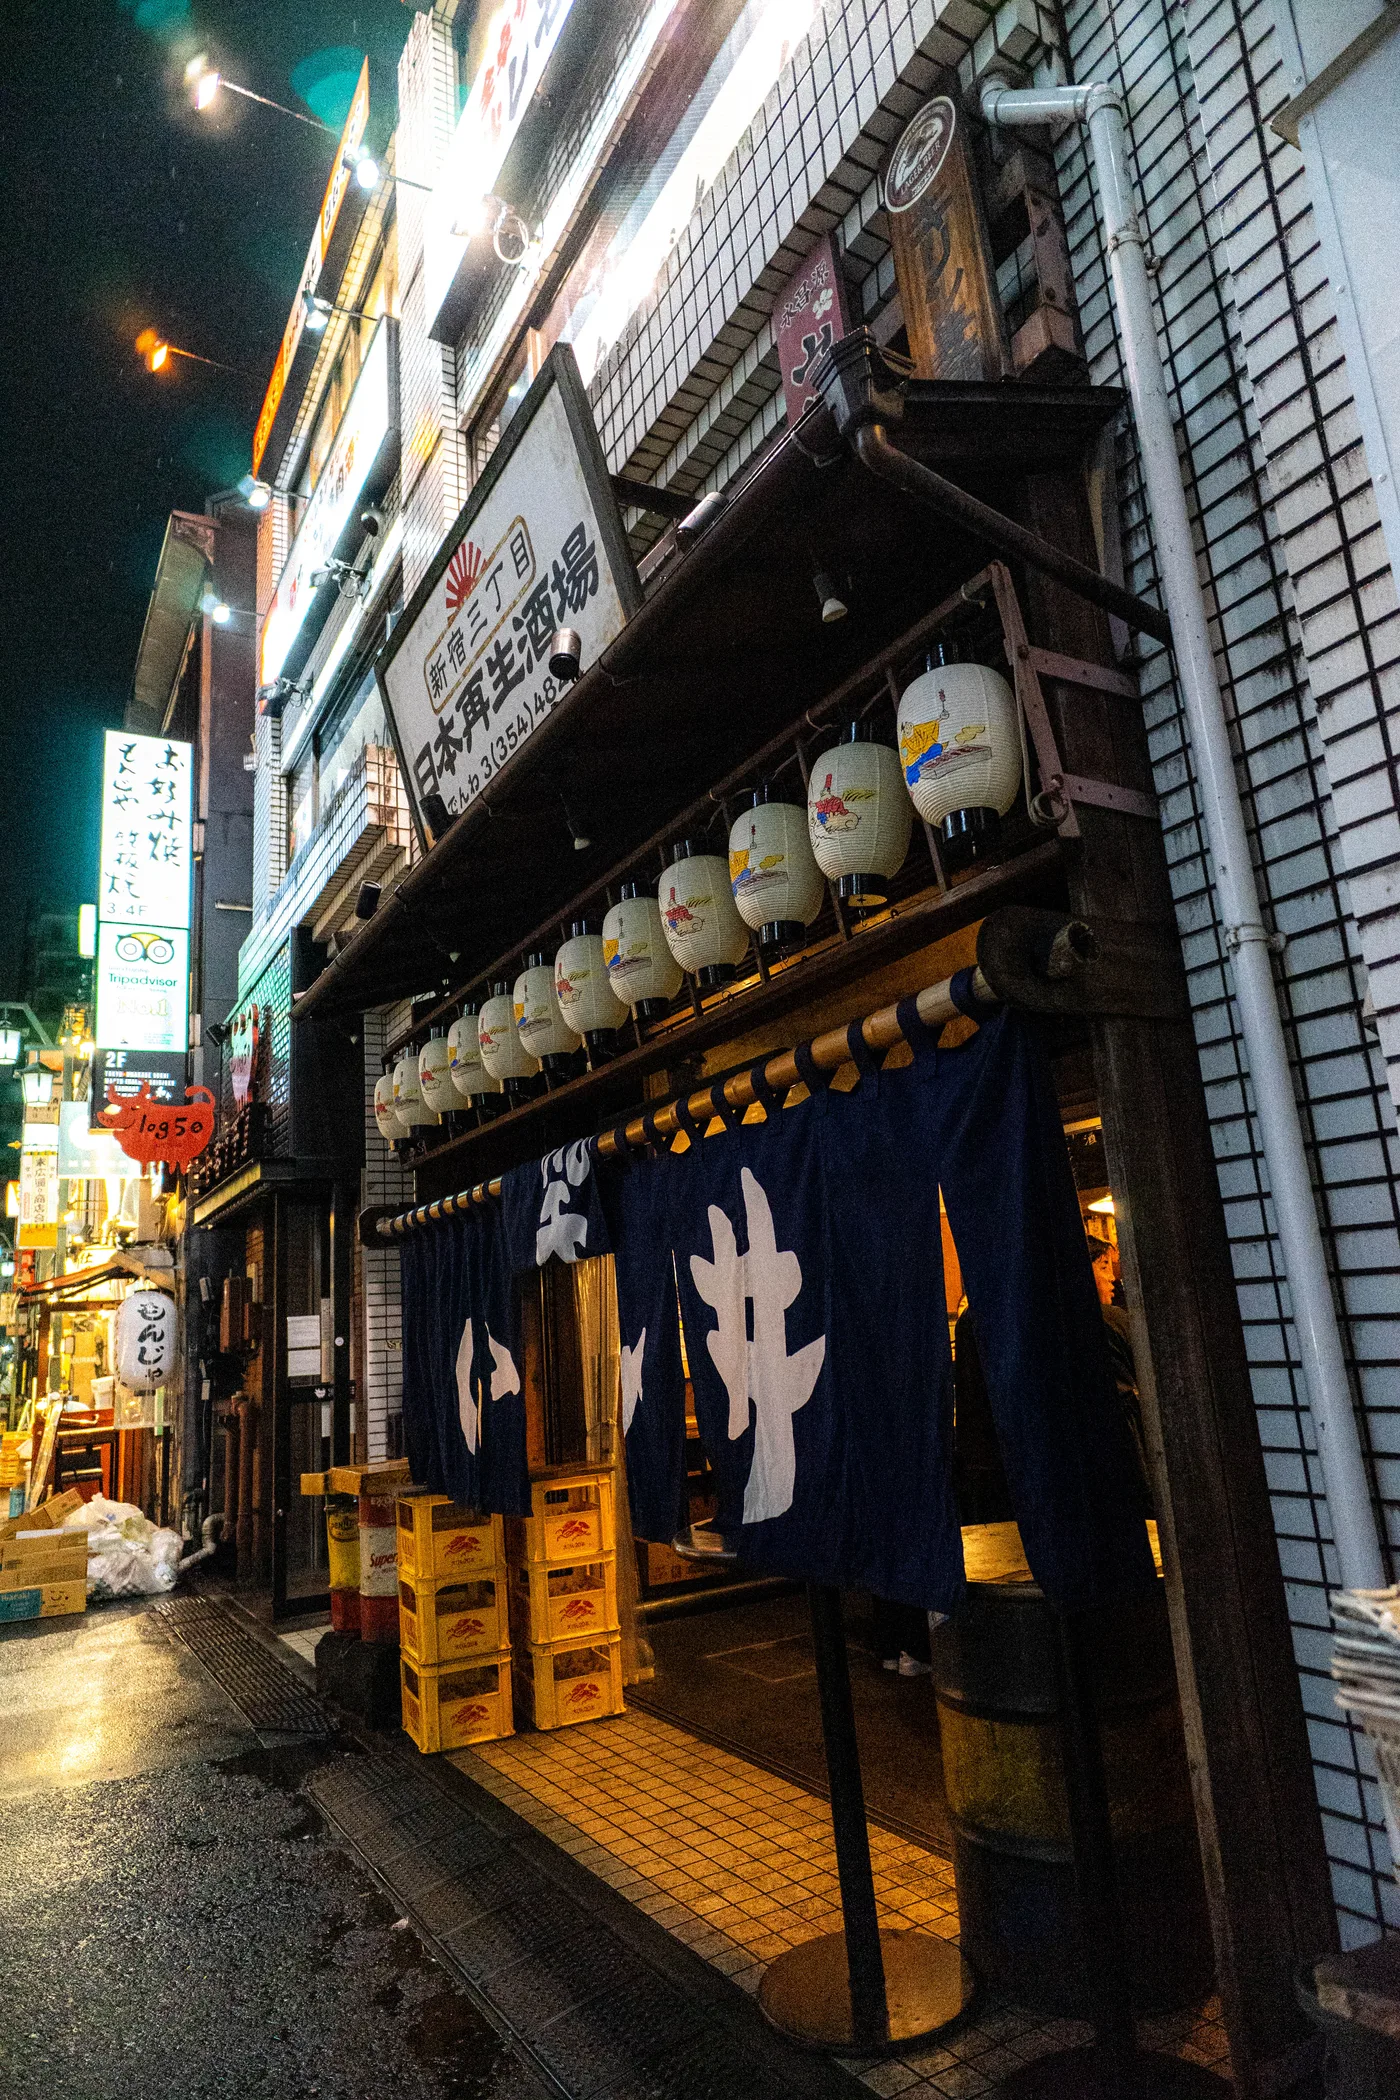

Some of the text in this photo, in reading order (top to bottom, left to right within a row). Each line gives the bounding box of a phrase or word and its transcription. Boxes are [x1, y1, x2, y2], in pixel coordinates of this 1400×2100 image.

[900, 163, 923, 195] LAGER
[922, 140, 941, 166] BEER
[429, 531, 531, 699] 新宿三丁目
[412, 521, 599, 799] 日本再生酒場
[108, 972, 178, 988] Tripadvisor
[105, 1050, 128, 1069] 2F
